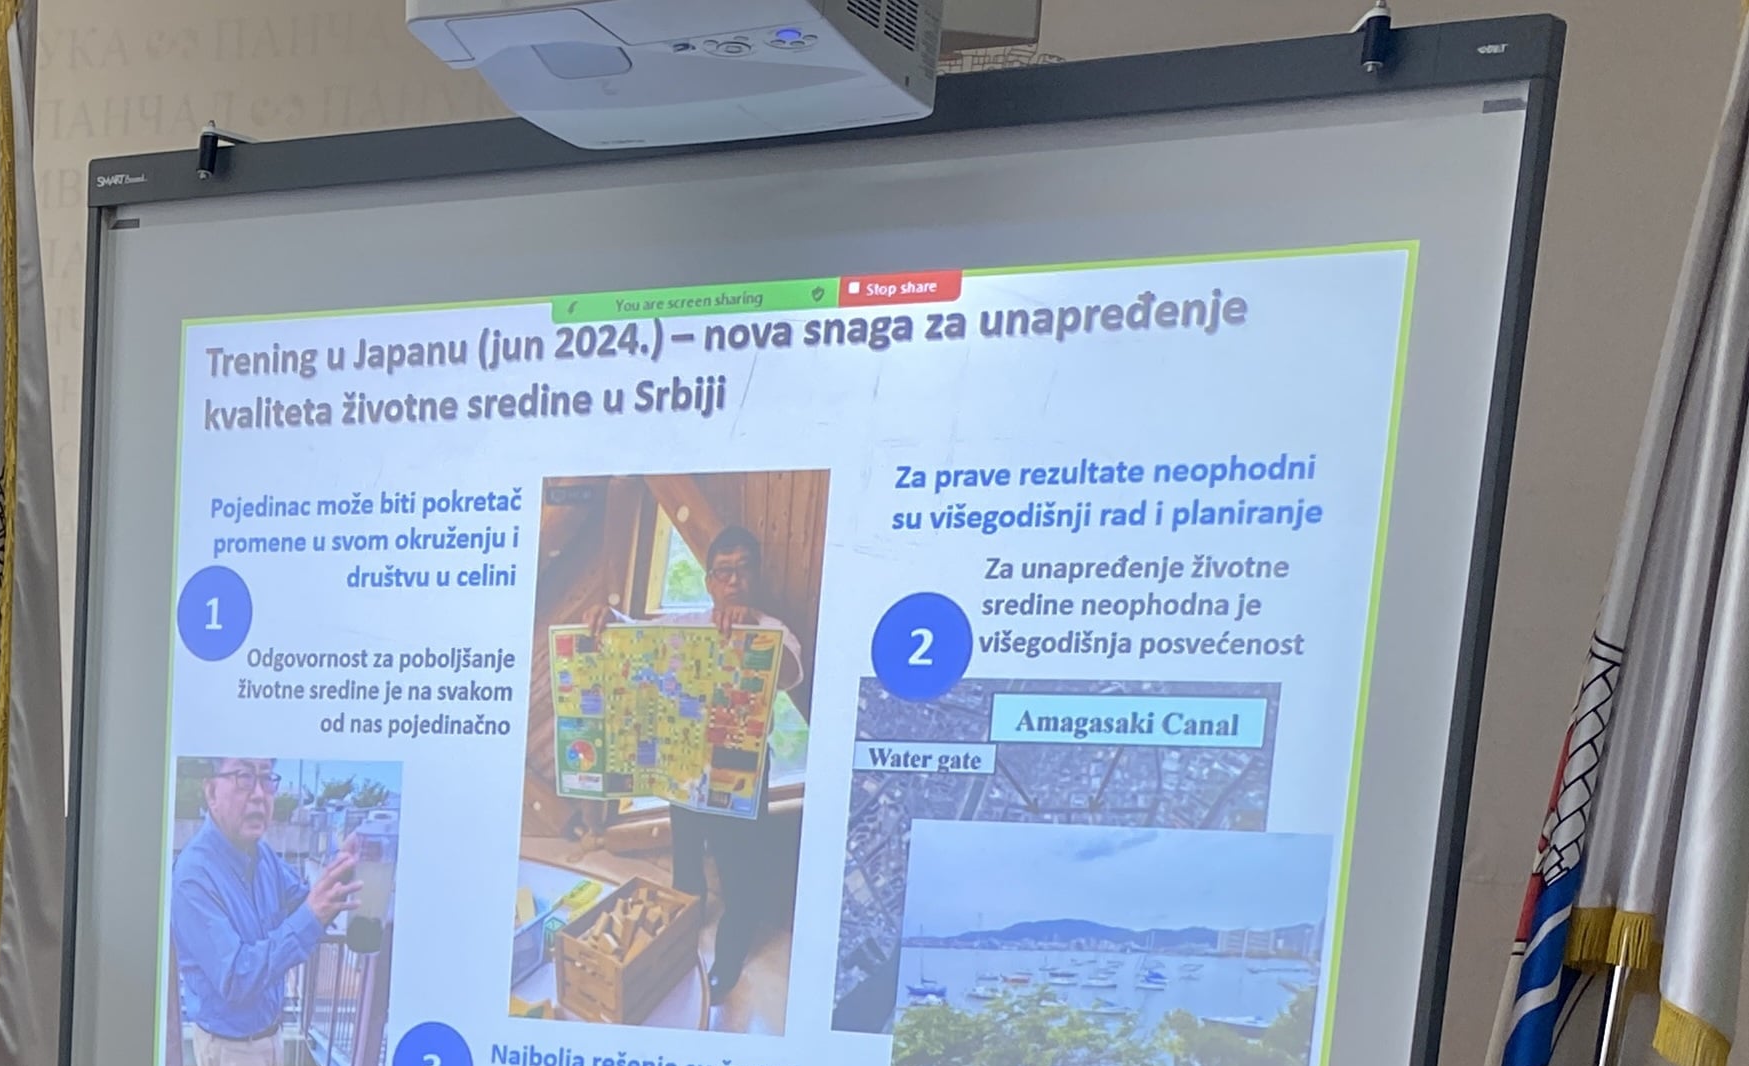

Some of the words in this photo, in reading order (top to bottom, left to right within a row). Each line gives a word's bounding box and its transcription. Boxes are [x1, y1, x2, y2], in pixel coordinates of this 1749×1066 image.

[615, 299, 639, 313] You
[641, 298, 664, 311] are
[667, 294, 712, 310] screen
[714, 290, 763, 310] sharing
[865, 282, 899, 299] Stop
[902, 279, 937, 295] share
[205, 342, 318, 380] Trening
[326, 348, 345, 372] u
[353, 337, 467, 375] Japanu
[478, 326, 544, 371] (jun
[555, 316, 664, 361] 2024.)
[704, 319, 793, 352] nova
[803, 311, 913, 351] snaga
[925, 311, 966, 340] za
[980, 288, 1249, 342] unapređenje
[204, 396, 332, 431] kvaliteta
[342, 391, 455, 425] životne
[467, 382, 592, 421] sredine
[602, 386, 624, 412] u
[634, 374, 727, 417] Srbiji
[895, 465, 926, 489] Za
[935, 467, 1012, 494] prave
[1019, 458, 1145, 487] rezultate
[1153, 454, 1317, 487] neophodni
[211, 495, 311, 523] Pojedinac
[317, 491, 374, 517] može
[380, 491, 416, 515] biti
[422, 487, 523, 519] pokretač
[892, 508, 923, 530] su
[929, 502, 1092, 535] višegodišnji
[1100, 500, 1147, 527] rad
[1155, 501, 1164, 527] i
[1172, 499, 1324, 533] planiranje
[213, 534, 306, 559] promene
[313, 537, 326, 552] u
[332, 534, 389, 552] svom
[395, 526, 506, 554] okruženju
[512, 526, 520, 549] i
[346, 564, 430, 589] društvu
[436, 571, 450, 588] u
[456, 563, 517, 588] celini
[984, 557, 1014, 580] Za
[1021, 554, 1185, 584] unapređenje
[1191, 554, 1290, 579] životne
[204, 597, 223, 631] 1
[981, 592, 1075, 617] sredine
[1081, 592, 1230, 621] neophodna
[1234, 594, 1262, 621] je
[907, 627, 935, 666] 2
[978, 630, 1132, 659] višegodišnja
[1139, 630, 1305, 659] posvećenost
[246, 647, 368, 673] Odgovornost
[373, 653, 394, 668] za
[399, 647, 516, 673] poboljšanje
[237, 678, 305, 701] životne
[309, 680, 380, 701] sredine
[383, 681, 403, 705] je
[408, 685, 432, 702] na
[437, 681, 513, 703] svakom
[320, 713, 346, 734] od
[350, 717, 383, 734] nas
[387, 714, 511, 739] pojedinačno
[1015, 709, 1154, 740] Amagasaki
[1162, 712, 1240, 737] Canal
[868, 746, 933, 769] Water
[937, 750, 982, 774] gate
